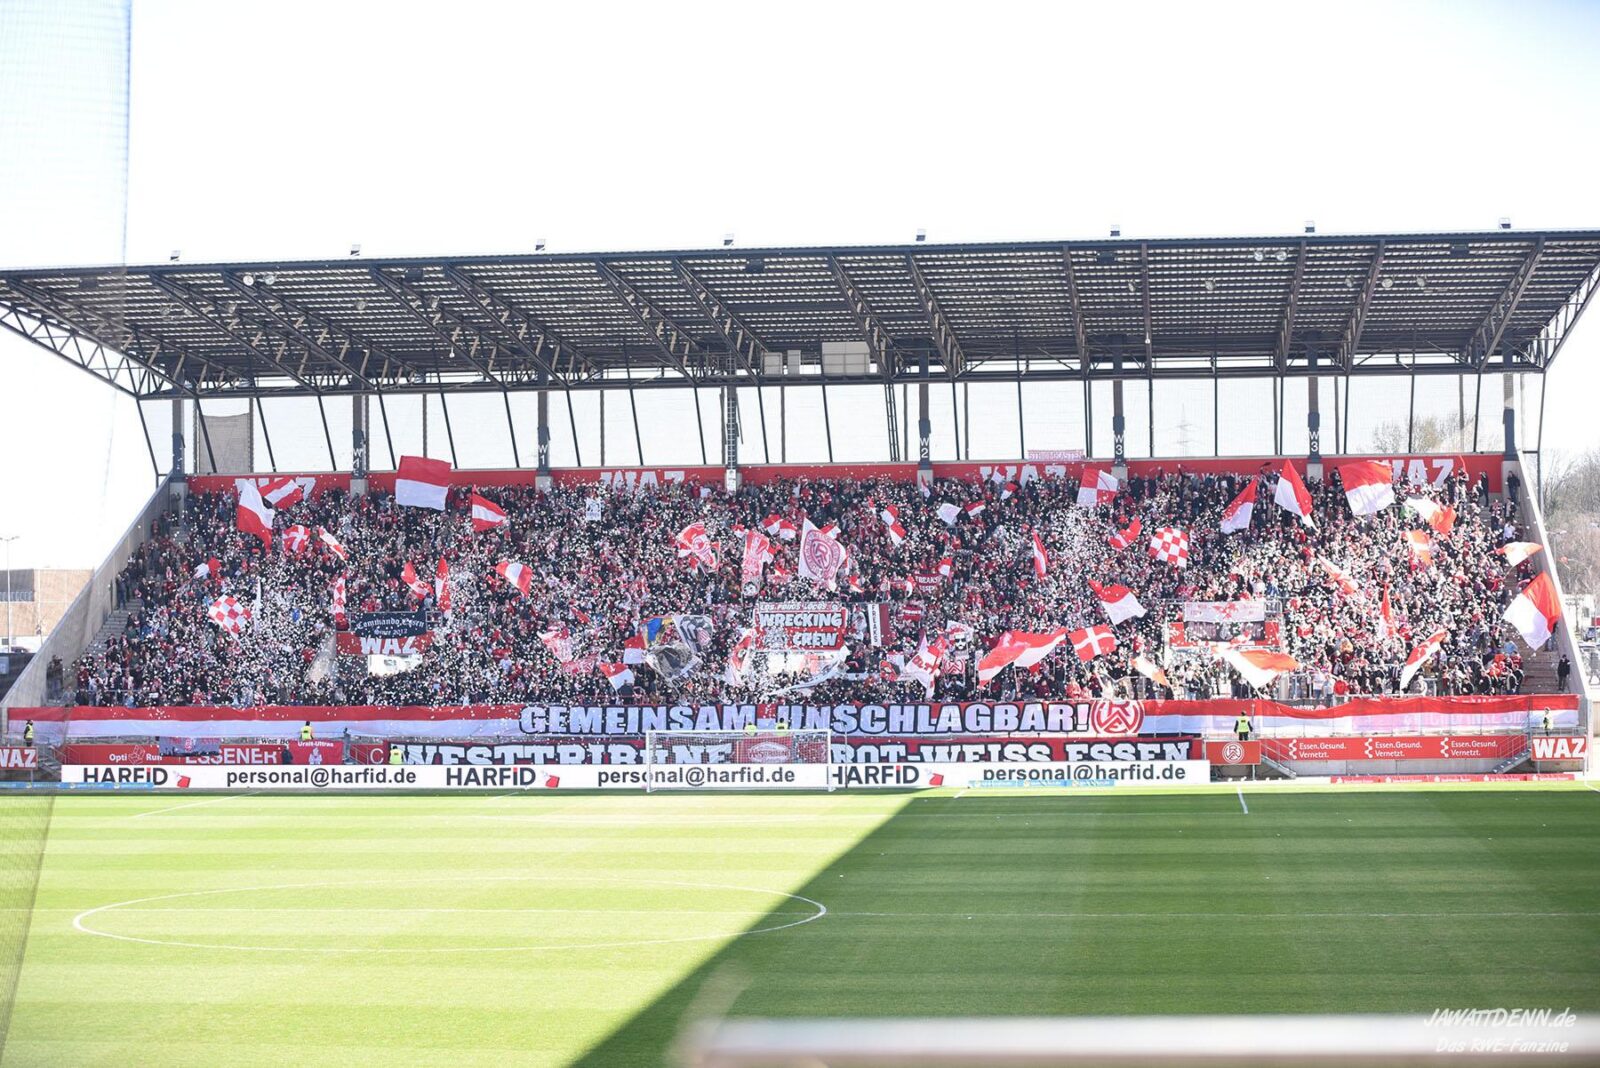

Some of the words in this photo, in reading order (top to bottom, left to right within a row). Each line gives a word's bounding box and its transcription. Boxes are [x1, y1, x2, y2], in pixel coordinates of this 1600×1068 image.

[921, 447, 929, 458] 2
[1115, 444, 1123, 455] 3
[1311, 441, 1319, 452] 3
[540, 455, 545, 465] 1
[758, 613, 842, 627] WRECKING
[792, 631, 838, 647] CREW
[519, 704, 756, 734] GEMEINSAM
[775, 702, 1090, 733] UNSCHLAGBAR!
[1065, 742, 1190, 761] ESSEN
[1533, 738, 1585, 759] WAZ
[109, 753, 127, 762] Opti
[146, 753, 162, 761] Run
[227, 768, 417, 788] personal@harfid.de
[598, 767, 796, 787] personal@harfid.de
[983, 764, 1187, 780] personal@harfid.de
